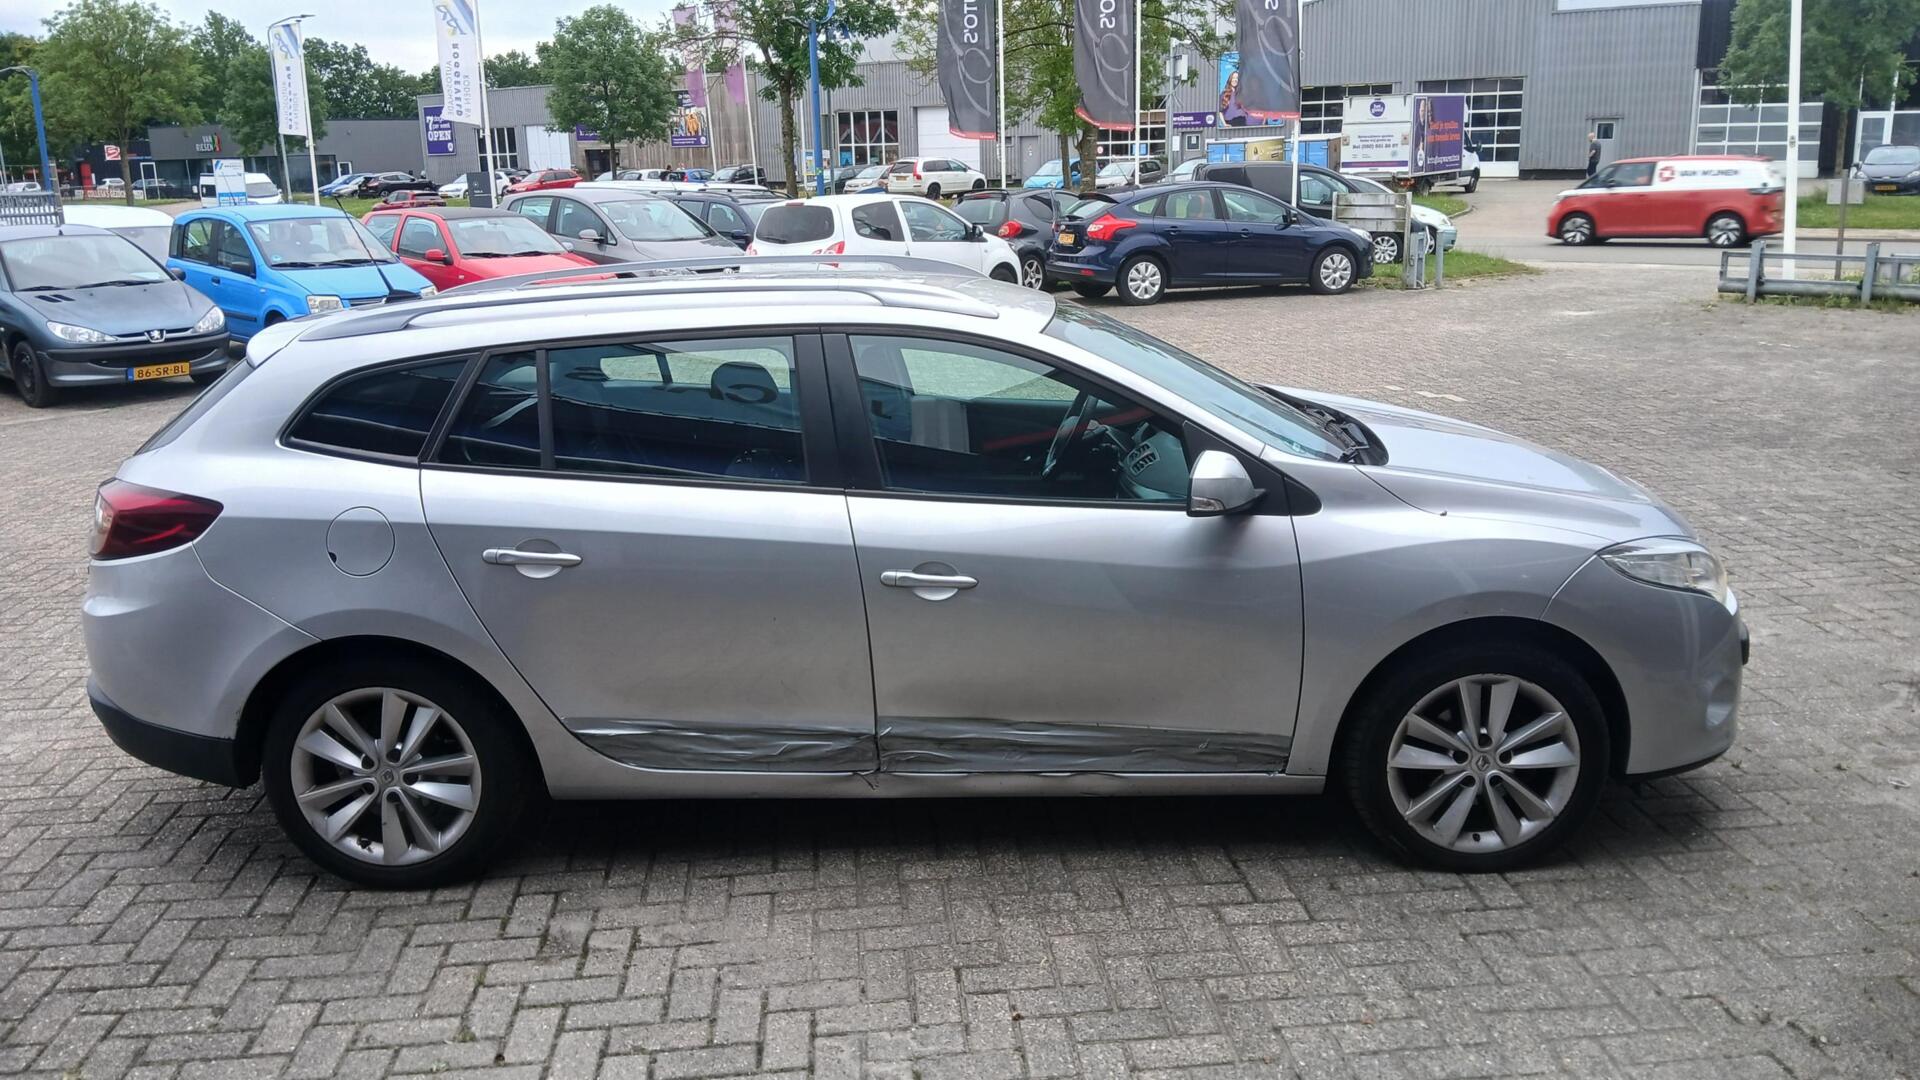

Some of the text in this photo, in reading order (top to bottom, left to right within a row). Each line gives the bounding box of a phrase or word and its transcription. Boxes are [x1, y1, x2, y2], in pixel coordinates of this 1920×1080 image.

[426, 116, 434, 131] 7
[201, 135, 212, 143] VAN
[428, 130, 451, 141] OPEN
[137, 364, 186, 379] 86-SR-BL
